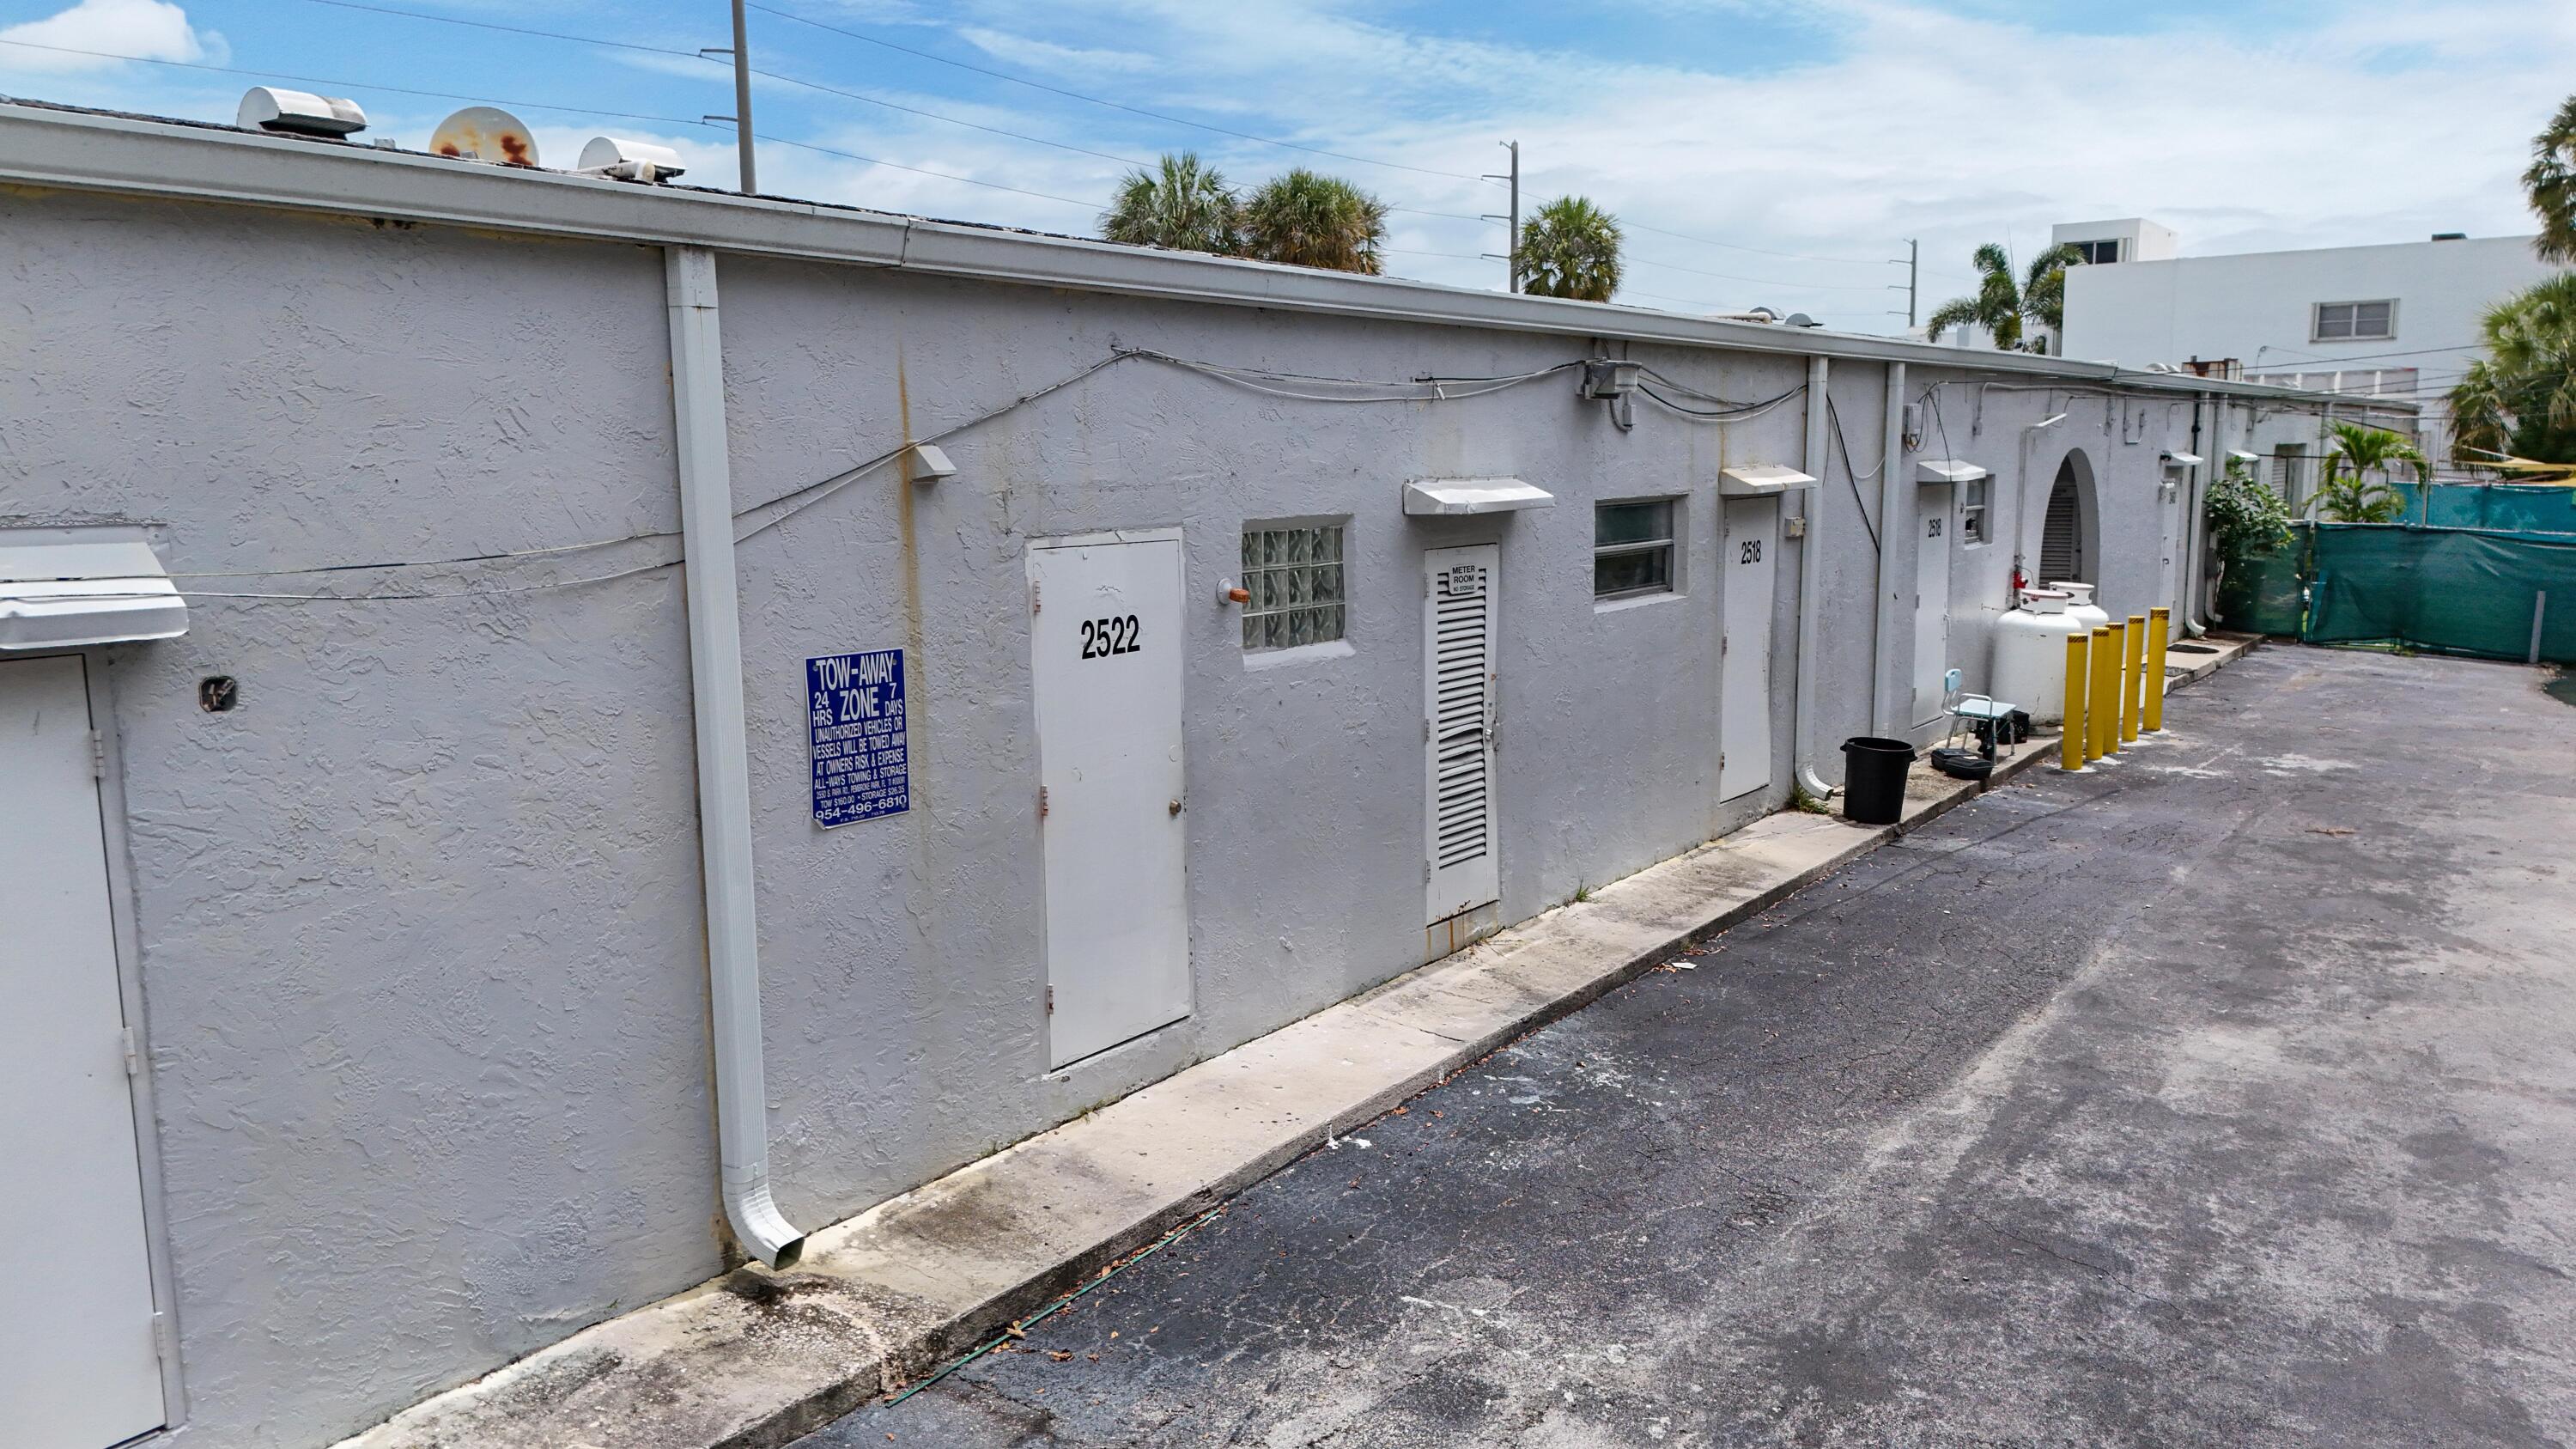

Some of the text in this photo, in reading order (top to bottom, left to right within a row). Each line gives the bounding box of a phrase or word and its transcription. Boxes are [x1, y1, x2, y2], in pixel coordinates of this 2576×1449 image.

[1928, 518, 1941, 538] 2518
[1741, 539, 1761, 564] 2518
[1452, 565, 1475, 575] METER
[1454, 575, 1474, 584] ROOM
[1081, 614, 1140, 660] 2522
[816, 652, 894, 691] TOW-AWAY
[814, 691, 829, 709] 24
[890, 682, 897, 699] 7
[840, 686, 879, 721] ZONE
[884, 698, 903, 716] DAYS
[812, 709, 833, 727] HRS
[815, 716, 903, 743] UNAUTHORIZED VEHICLES OR
[813, 731, 906, 759] VESSELS WILL BE TOWED AWAY
[817, 748, 904, 776] AT OWNERS RISK & EXPENSE
[814, 774, 846, 790] ALL-WAYS
[848, 770, 872, 784] TOWING
[873, 769, 878, 780] &
[879, 764, 907, 778] STORAGE
[815, 795, 907, 819] 954-496-6810
[820, 799, 833, 809] TOW
[861, 789, 887, 801] STORAGE
